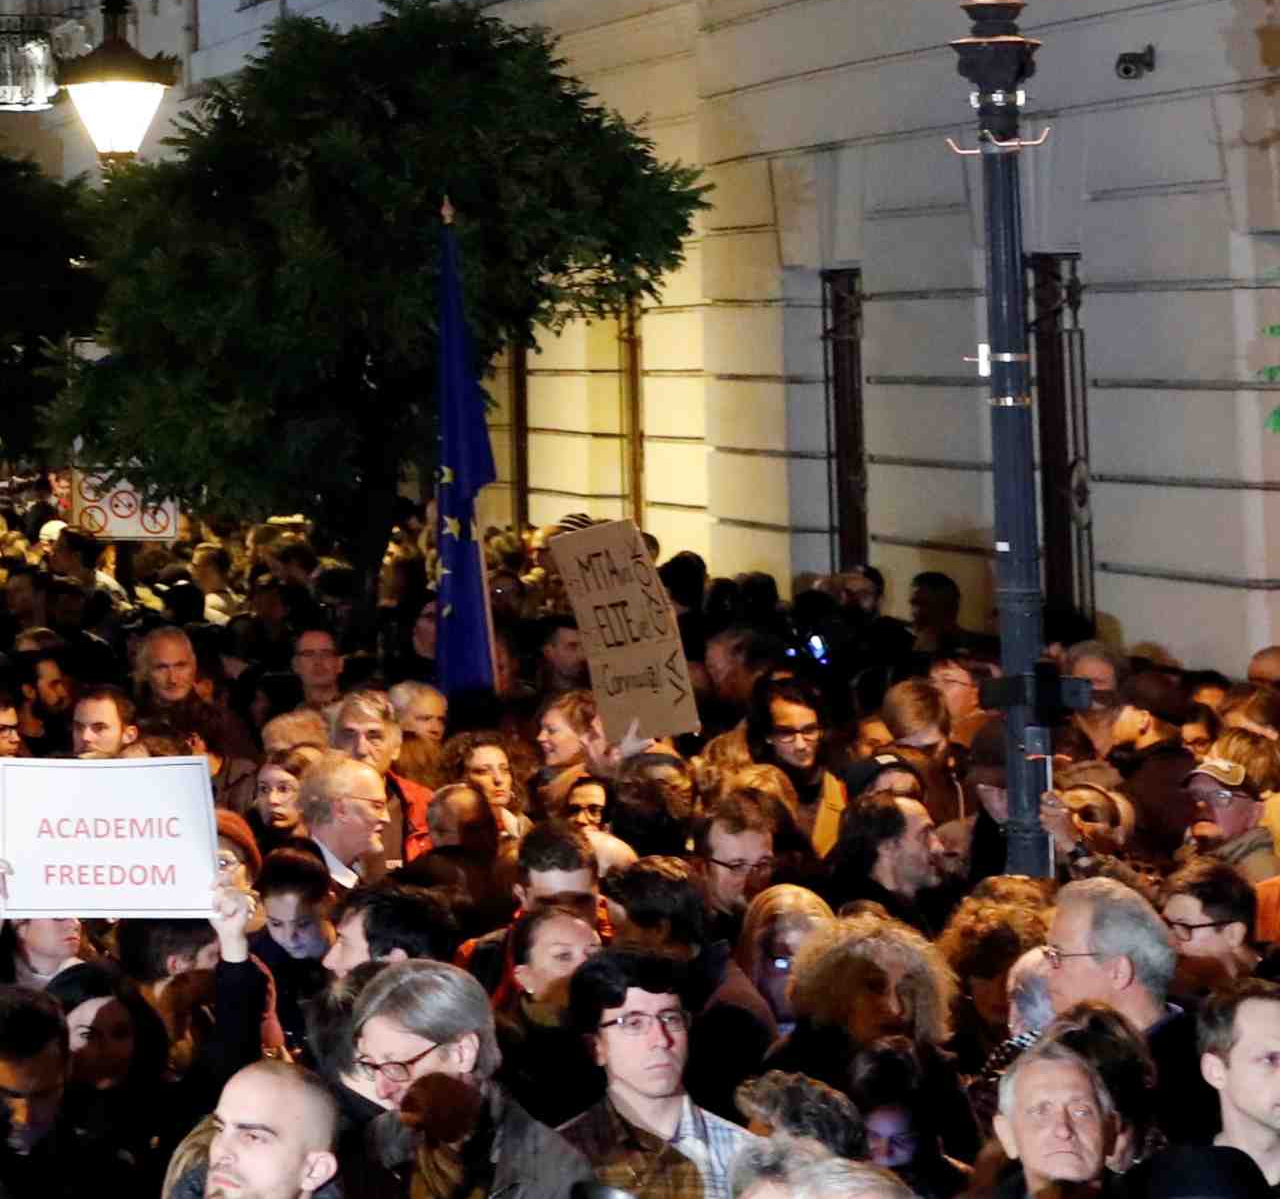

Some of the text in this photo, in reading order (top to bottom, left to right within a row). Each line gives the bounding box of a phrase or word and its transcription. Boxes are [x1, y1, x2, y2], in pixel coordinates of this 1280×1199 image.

[574, 549, 618, 593] MTA
[592, 599, 641, 649] ELTE
[36, 816, 182, 840] ACADEMIC
[43, 864, 177, 886] FREEDOM
